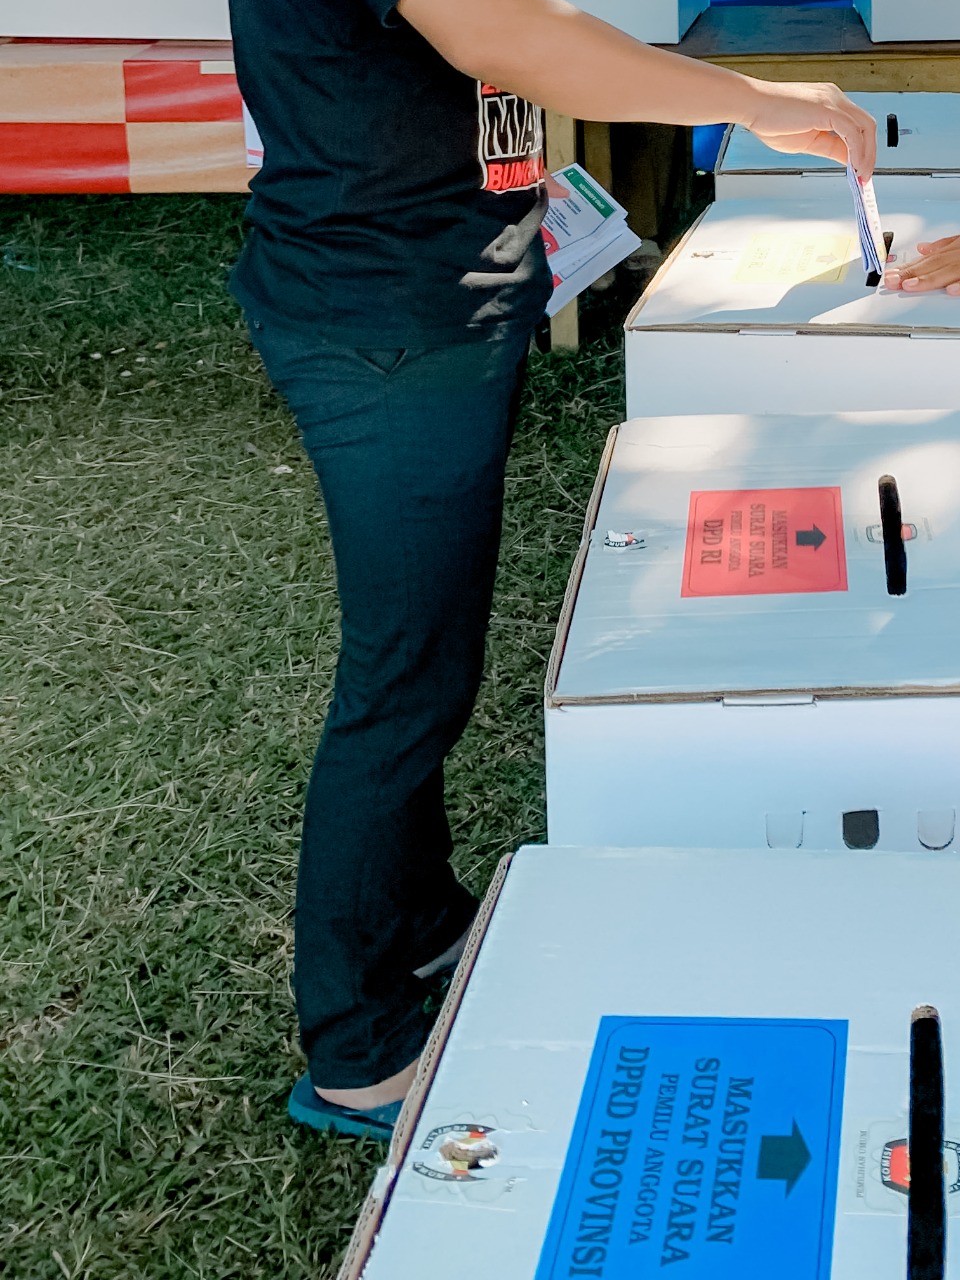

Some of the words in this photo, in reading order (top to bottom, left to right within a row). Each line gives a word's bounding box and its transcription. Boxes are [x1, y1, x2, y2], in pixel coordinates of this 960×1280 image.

[703, 519, 724, 545] DPD
[750, 503, 765, 536] SURAT
[771, 510, 788, 569] MASUKKAN
[701, 549, 722, 565] RI
[748, 541, 765, 578] SUARA
[606, 1046, 650, 1120] DPRD
[649, 1073, 680, 1142] PEMILU
[682, 1057, 721, 1149] SURAT
[705, 1076, 755, 1245] MASUKKAN
[859, 1130, 867, 1155] UMUM
[881, 1147, 892, 1182] KOMISI
[568, 1128, 632, 1278] PROVINSI
[628, 1147, 666, 1245] ANGGOTA
[857, 1157, 866, 1198] PEMILIHAN
[660, 1159, 705, 1267] SUARA
